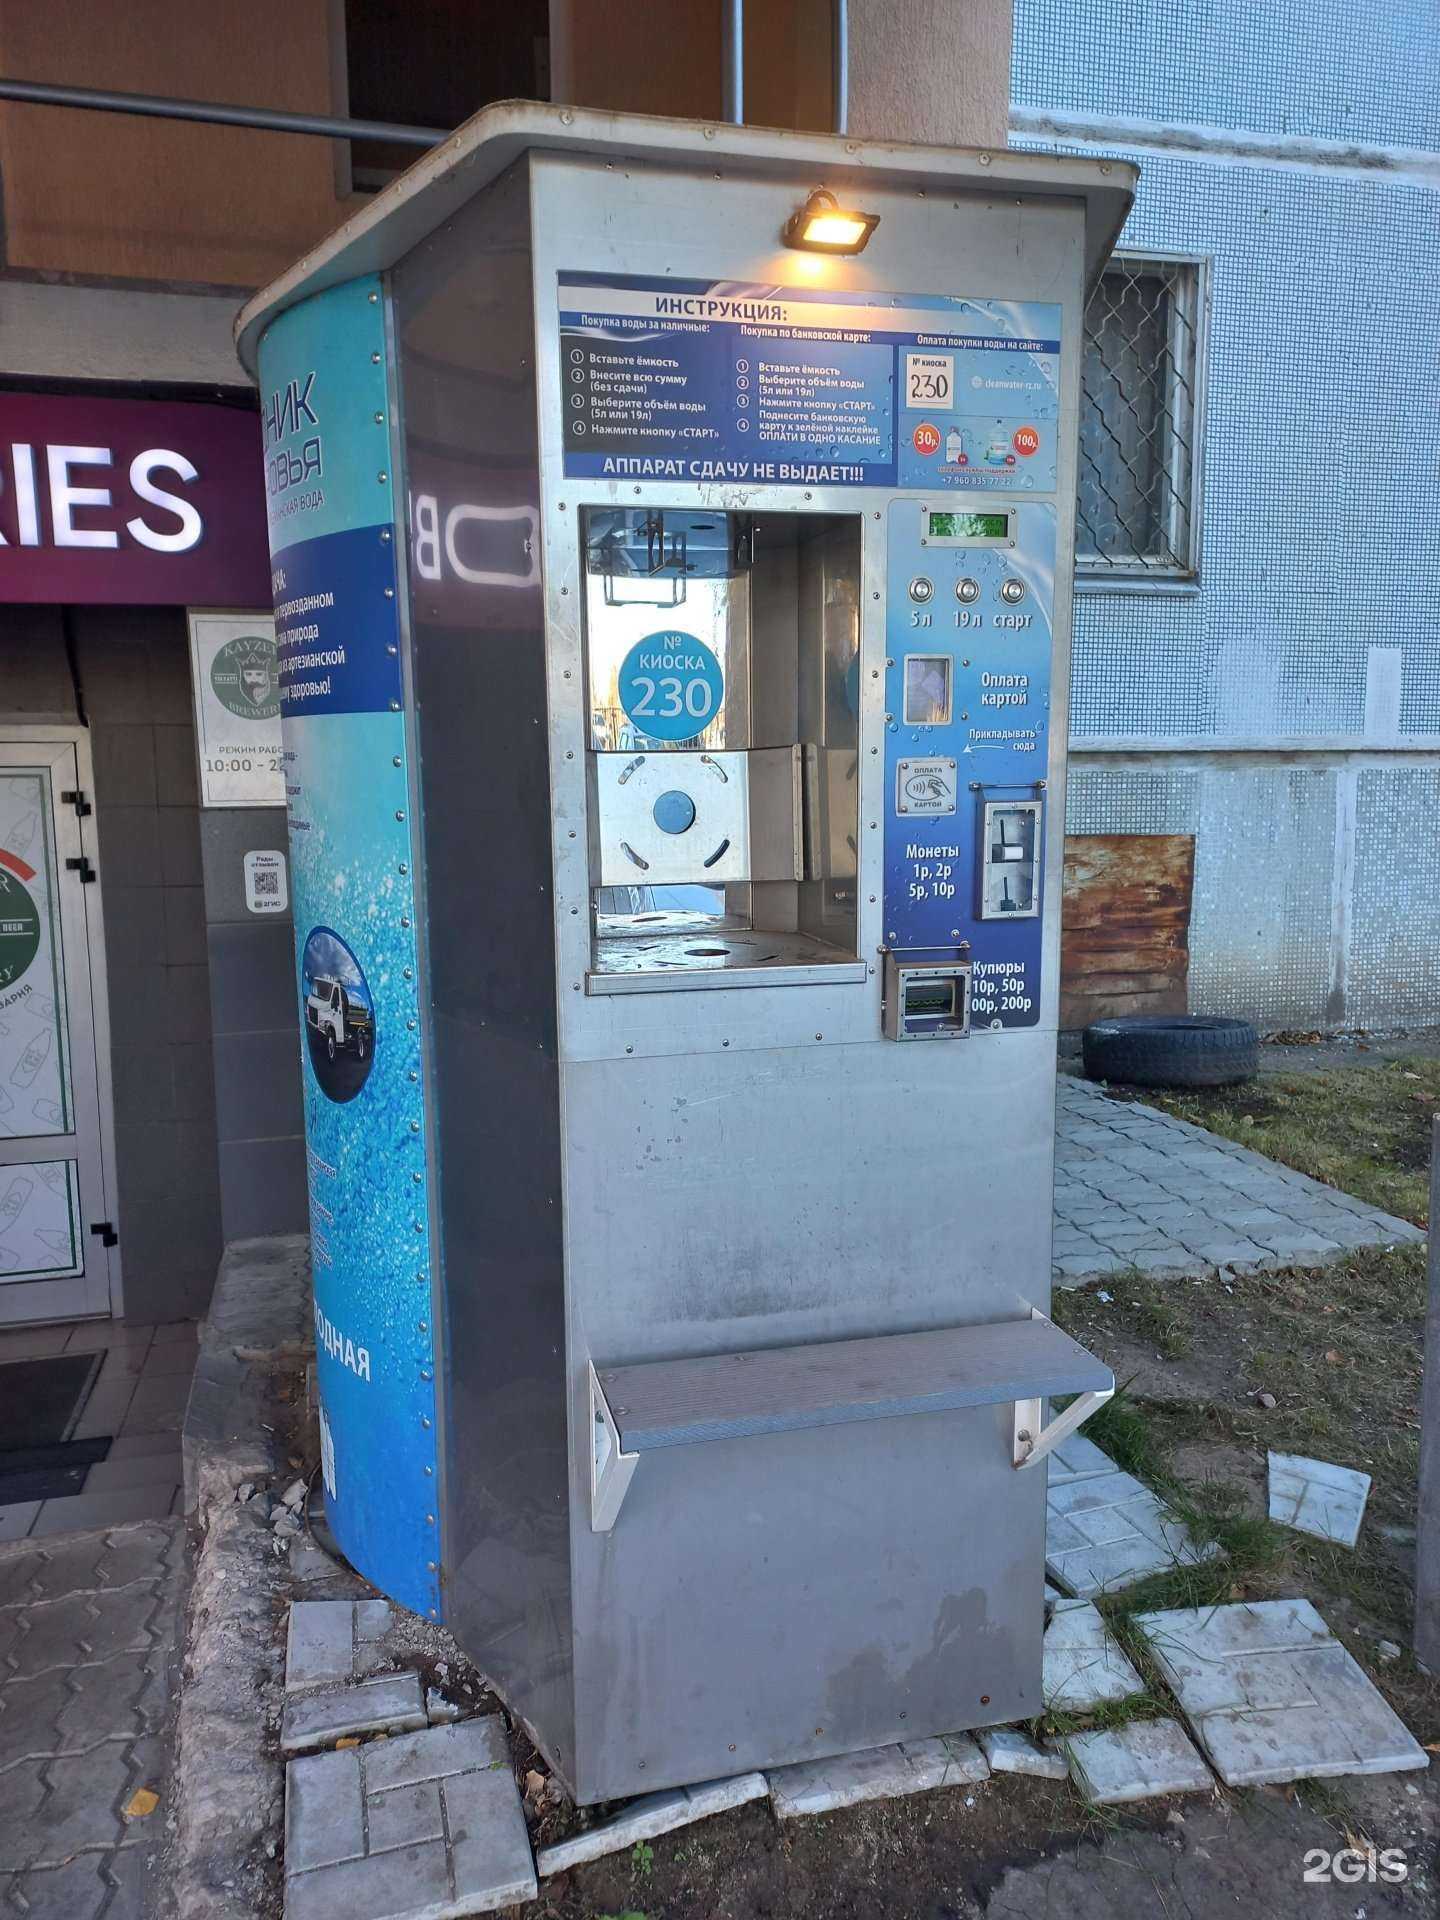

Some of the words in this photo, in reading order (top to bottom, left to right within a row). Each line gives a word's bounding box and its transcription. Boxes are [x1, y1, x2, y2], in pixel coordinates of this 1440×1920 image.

[655, 297, 788, 322] ИНСТРУКЦИЯ:
[581, 314, 620, 328] Покупка
[622, 319, 647, 330] воды
[649, 320, 659, 329] за
[661, 321, 711, 333] наличные:
[741, 325, 778, 339] Покупка
[779, 329, 790, 338] по
[792, 328, 842, 341] банковской
[843, 332, 871, 344] карте:
[917, 334, 947, 346] Оплата
[948, 337, 983, 350] покупки
[984, 340, 1006, 350] воды
[1007, 340, 1018, 350] на
[1019, 340, 1043, 351] сайте:
[589, 352, 635, 365] Вставьте
[636, 355, 680, 368] ёмкость
[921, 359, 947, 369] киоска
[758, 362, 800, 374] Вставьте
[801, 364, 841, 376] ёмкость
[589, 369, 632, 382] Внесите
[633, 373, 653, 383] всю
[654, 375, 687, 387] сумму
[758, 374, 806, 388] Выберите
[807, 376, 838, 388] объём
[840, 380, 865, 390] воды
[911, 374, 948, 398] 230
[590, 381, 612, 393] (без
[613, 383, 647, 395] сдачи)
[759, 386, 774, 397] (5л
[775, 388, 793, 396] или
[795, 387, 815, 398] 19л)
[590, 396, 642, 410] Выберите
[643, 398, 677, 411] объём
[679, 402, 706, 412] воды
[759, 397, 801, 408] Нажмите
[803, 401, 837, 411] кнопку
[838, 400, 875, 411] «СТАРТ»
[591, 410, 607, 421] (5л
[608, 412, 628, 420] или
[631, 410, 652, 422] 19л)
[759, 410, 808, 422] Поднесите
[810, 412, 866, 425] банковскую
[591, 424, 638, 436] Нажмите
[640, 427, 676, 439] кнопку
[678, 427, 719, 438] «СТАРТ»
[759, 422, 786, 431] карту
[788, 423, 794, 431] к
[795, 423, 834, 433] зелёной
[835, 424, 879, 434] наклейке
[759, 431, 798, 442] ОПЛАТИ
[800, 433, 806, 442] В
[808, 433, 836, 445] ОДНО
[838, 434, 881, 445] КАСАНИЕ
[602, 457, 685, 478] АППАРАТ
[689, 460, 749, 481] СДАЧУ
[753, 462, 775, 479] НЕ
[780, 464, 864, 483] ВЫДАЕТ!!!
[0, 443, 203, 552] IES
[300, 489, 324, 512] ВОДА
[910, 611, 919, 627] 5
[920, 614, 931, 627] л
[953, 610, 970, 627] 19
[971, 614, 982, 628] л
[992, 612, 1032, 631] старт
[287, 624, 319, 647] природа
[664, 635, 682, 651] №
[639, 654, 706, 671] КИОСКА
[981, 671, 1028, 687] Оплата
[290, 675, 331, 701] здоровью!
[631, 677, 712, 717] 230
[981, 688, 1027, 708] картой
[969, 728, 1036, 741] Прикладывать
[1012, 741, 1035, 752] сюда
[206, 759, 252, 772] 10:00
[906, 843, 959, 859] Монеты
[913, 863, 933, 880] 1р,
[935, 863, 951, 880] 2р
[909, 882, 929, 899] 5р,
[932, 881, 955, 899] 10р
[973, 961, 1025, 977] Купюры
[972, 979, 999, 996] 10р,
[1001, 978, 1025, 995] 50р
[971, 997, 999, 1014] 00р,
[1001, 996, 1032, 1013] 200р
